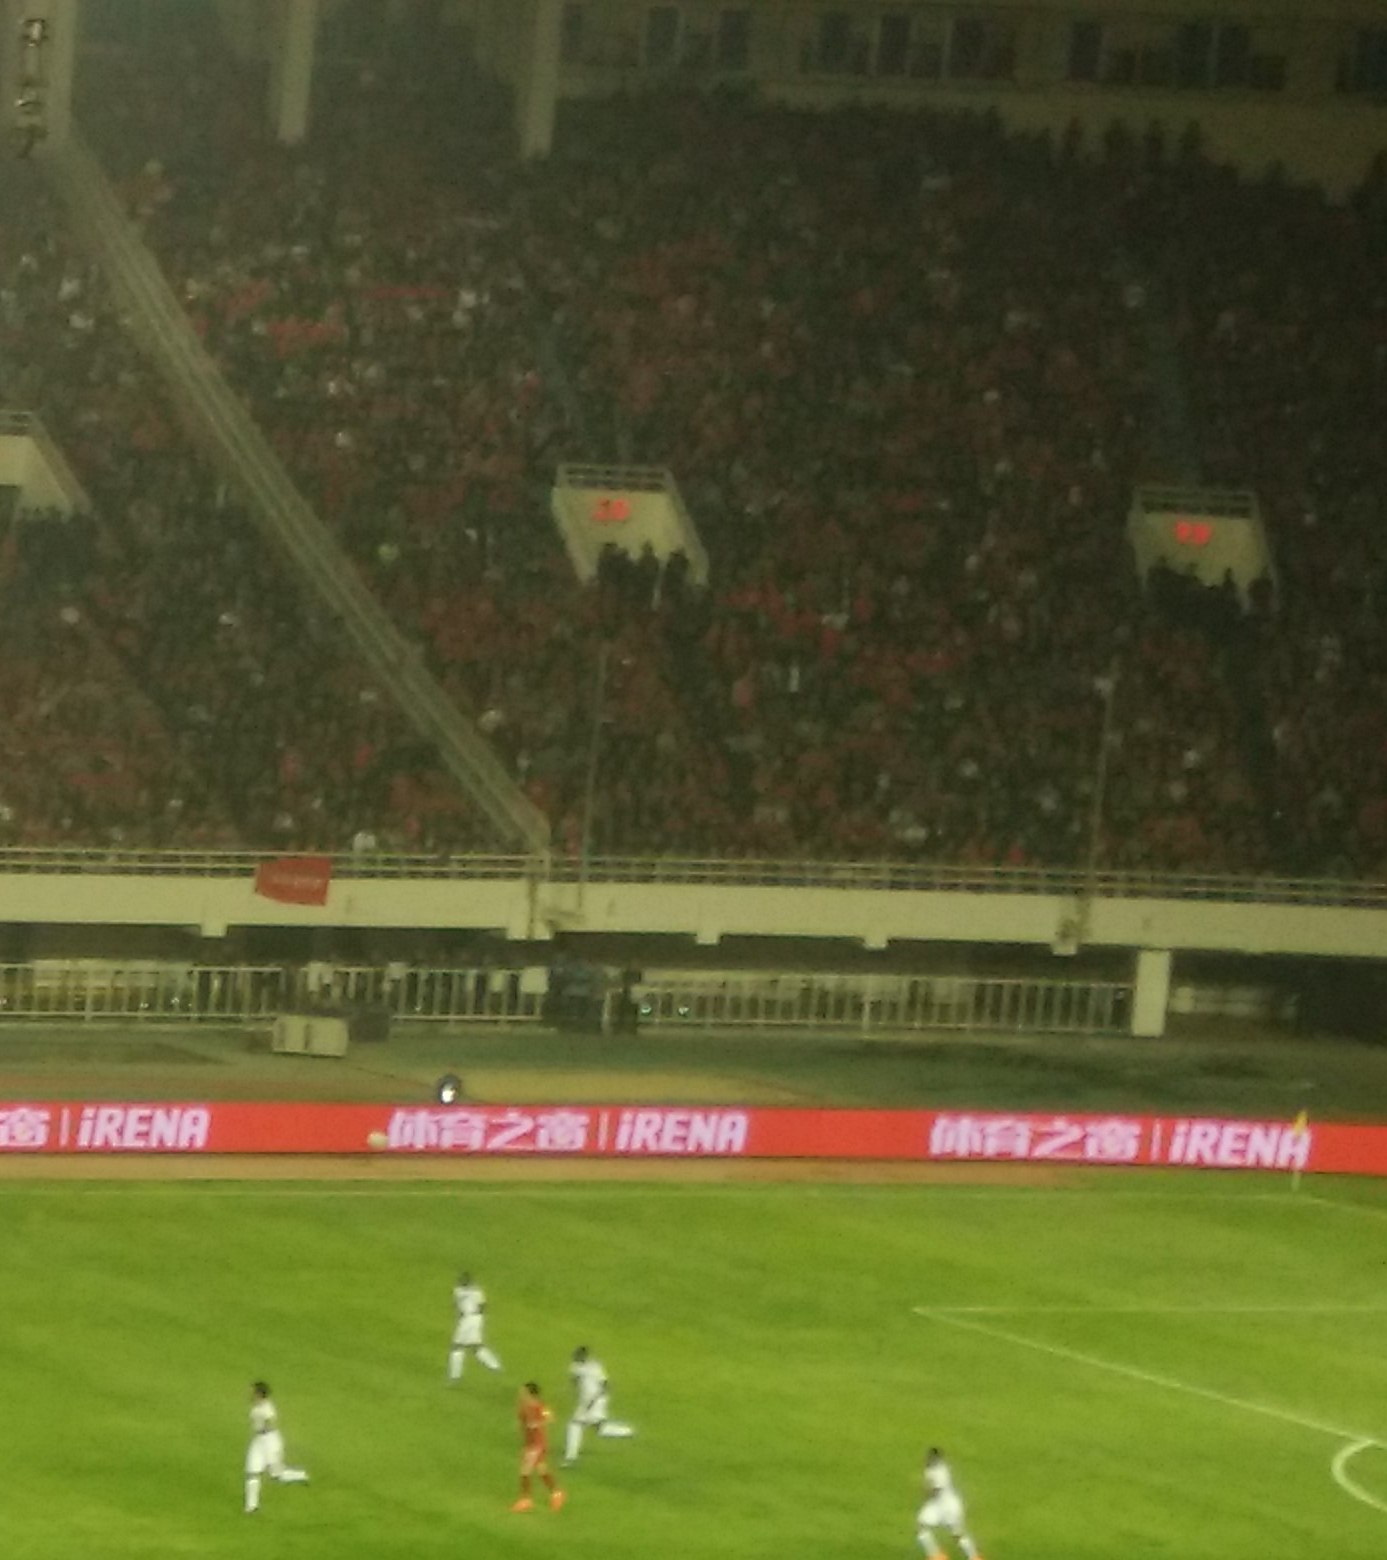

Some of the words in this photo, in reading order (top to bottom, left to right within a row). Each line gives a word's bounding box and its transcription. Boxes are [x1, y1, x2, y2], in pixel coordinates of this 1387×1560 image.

[386, 1107, 590, 1151] 体育之窗
[929, 1114, 1142, 1160] 体育之窗
